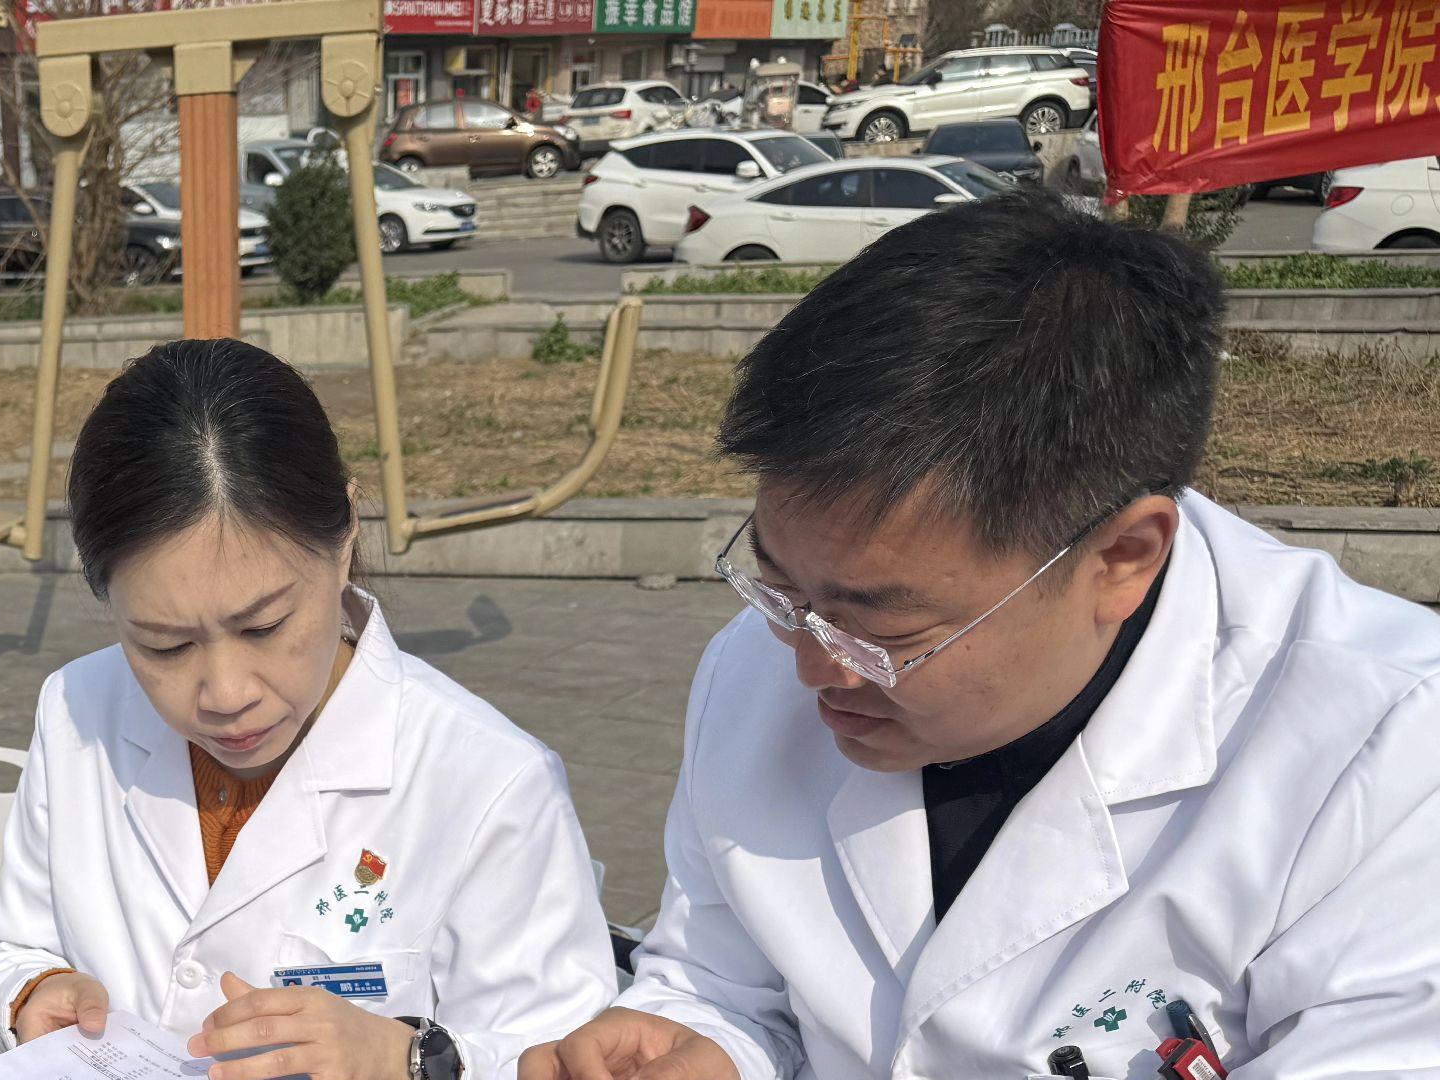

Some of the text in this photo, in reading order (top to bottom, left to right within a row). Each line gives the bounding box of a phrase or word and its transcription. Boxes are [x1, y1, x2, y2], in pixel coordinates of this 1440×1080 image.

[1152, 0, 1440, 155] 邢台医学院
